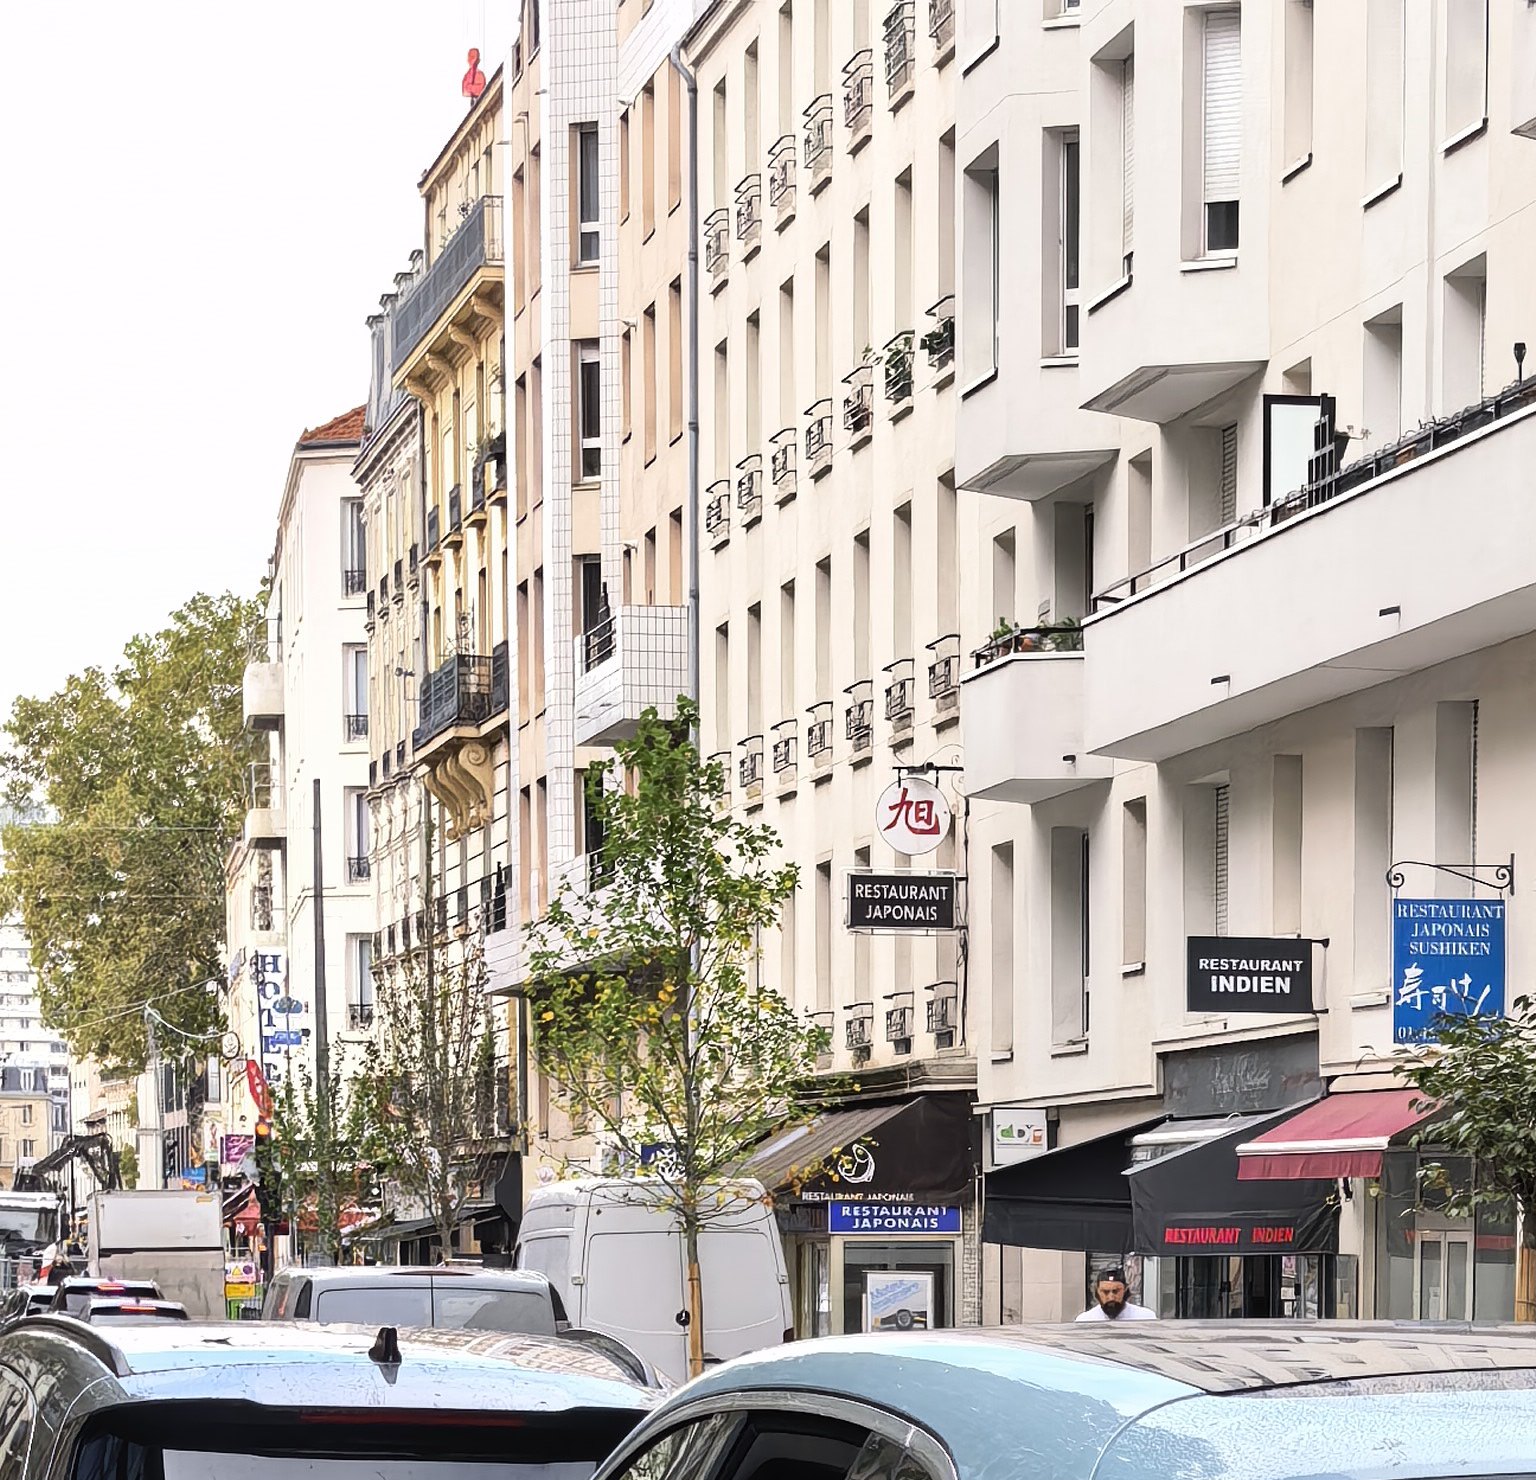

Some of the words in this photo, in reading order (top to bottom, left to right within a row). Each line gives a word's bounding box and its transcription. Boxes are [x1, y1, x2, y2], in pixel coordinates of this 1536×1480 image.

[883, 787, 941, 835] 旭
[855, 884, 949, 901] RESTAURANT
[865, 904, 938, 921] JAPONAIS
[1397, 904, 1504, 919] RESTAURANT
[1411, 922, 1490, 937] JAPONAIS
[1409, 941, 1491, 956] SUSHIKEN
[1199, 958, 1304, 972] RESTAURANT
[1211, 975, 1291, 994] INDIEN
[802, 1191, 864, 1201] RESTAURANT
[841, 1206, 947, 1217] RESTAURANT
[852, 1218, 939, 1229] JAPONAIS
[1165, 1227, 1242, 1244] RESTAURANT
[1252, 1226, 1294, 1243] INDIEN
